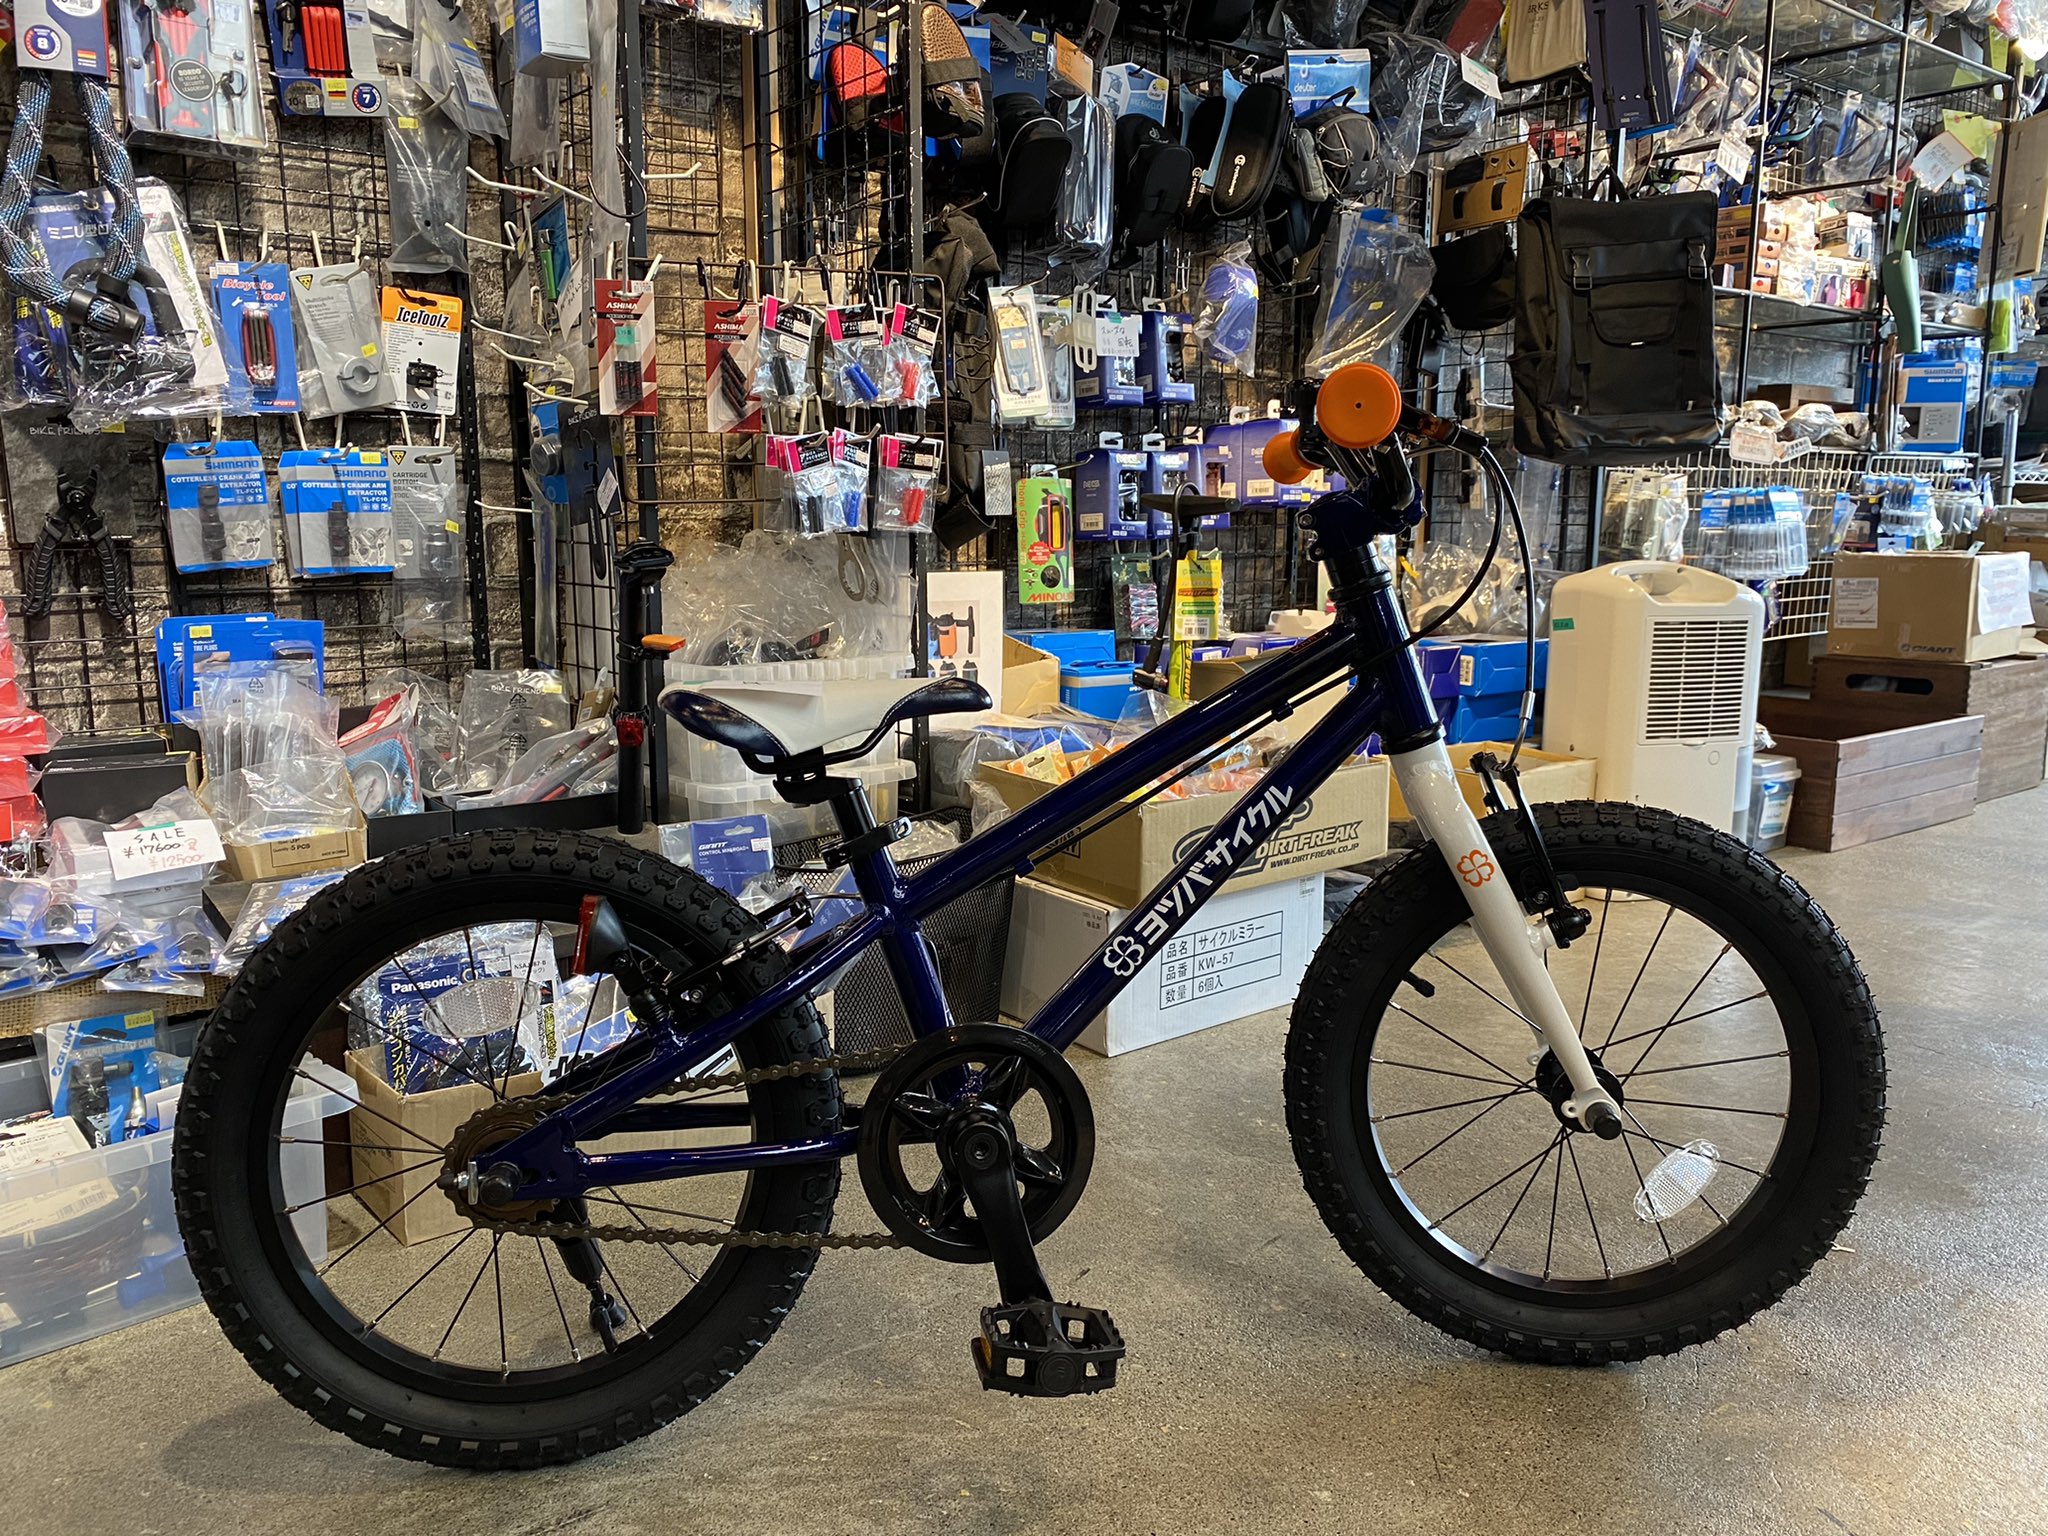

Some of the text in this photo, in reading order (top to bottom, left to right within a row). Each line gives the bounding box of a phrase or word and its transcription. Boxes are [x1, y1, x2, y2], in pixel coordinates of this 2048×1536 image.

[37, 37, 49, 50] 8
[178, 68, 202, 77] BORDO
[1294, 82, 1316, 93] deuter
[362, 94, 370, 104] 7
[28, 203, 81, 214] anasonic
[222, 279, 274, 290] Bicycle
[255, 290, 287, 302] Tool
[606, 302, 638, 310] ASHIMA
[396, 306, 450, 329] IceToolz
[713, 322, 744, 330] ASHIMA
[1923, 368, 1964, 376] SHIMANO
[29, 426, 55, 436] BIKE
[204, 460, 260, 470] SHIMANO
[171, 472, 261, 484] COTTERLESS CRANK ARM
[335, 470, 387, 478] SHIMANO
[219, 481, 262, 489] EXTRACTOR
[1910, 645, 1957, 654] GIANT
[133, 827, 186, 844] SALE
[698, 841, 728, 850] GIANT
[1134, 784, 1294, 946] ヨツバサイクル
[1166, 923, 1266, 958] 品名 サイクルミラー
[1166, 951, 1235, 982] 品番 KW-57
[391, 976, 459, 994] Panasonic
[1165, 980, 1224, 1004] 数量 6個入
[82, 1045, 114, 1056] CONTROL
